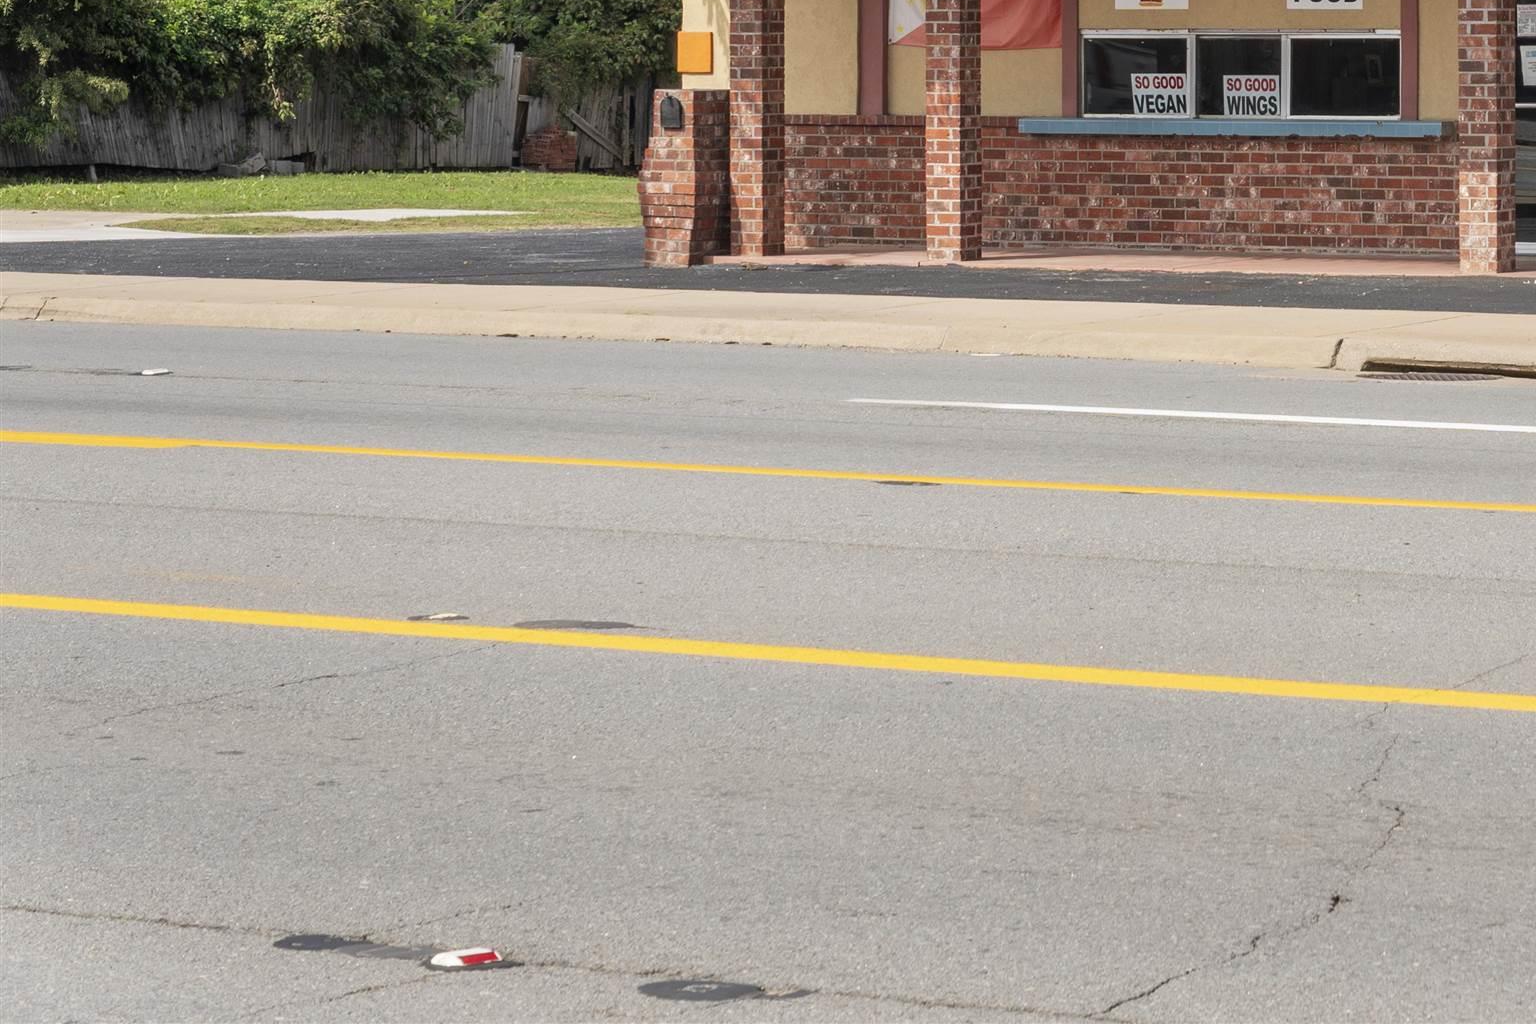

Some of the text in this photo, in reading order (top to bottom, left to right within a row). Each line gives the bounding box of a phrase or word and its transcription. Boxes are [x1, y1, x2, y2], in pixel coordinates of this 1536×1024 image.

[1135, 76, 1184, 89] SO GOOD
[1226, 78, 1276, 92] SO GOOD
[1134, 94, 1186, 113] VEGAN
[1227, 95, 1277, 115] WINGS
